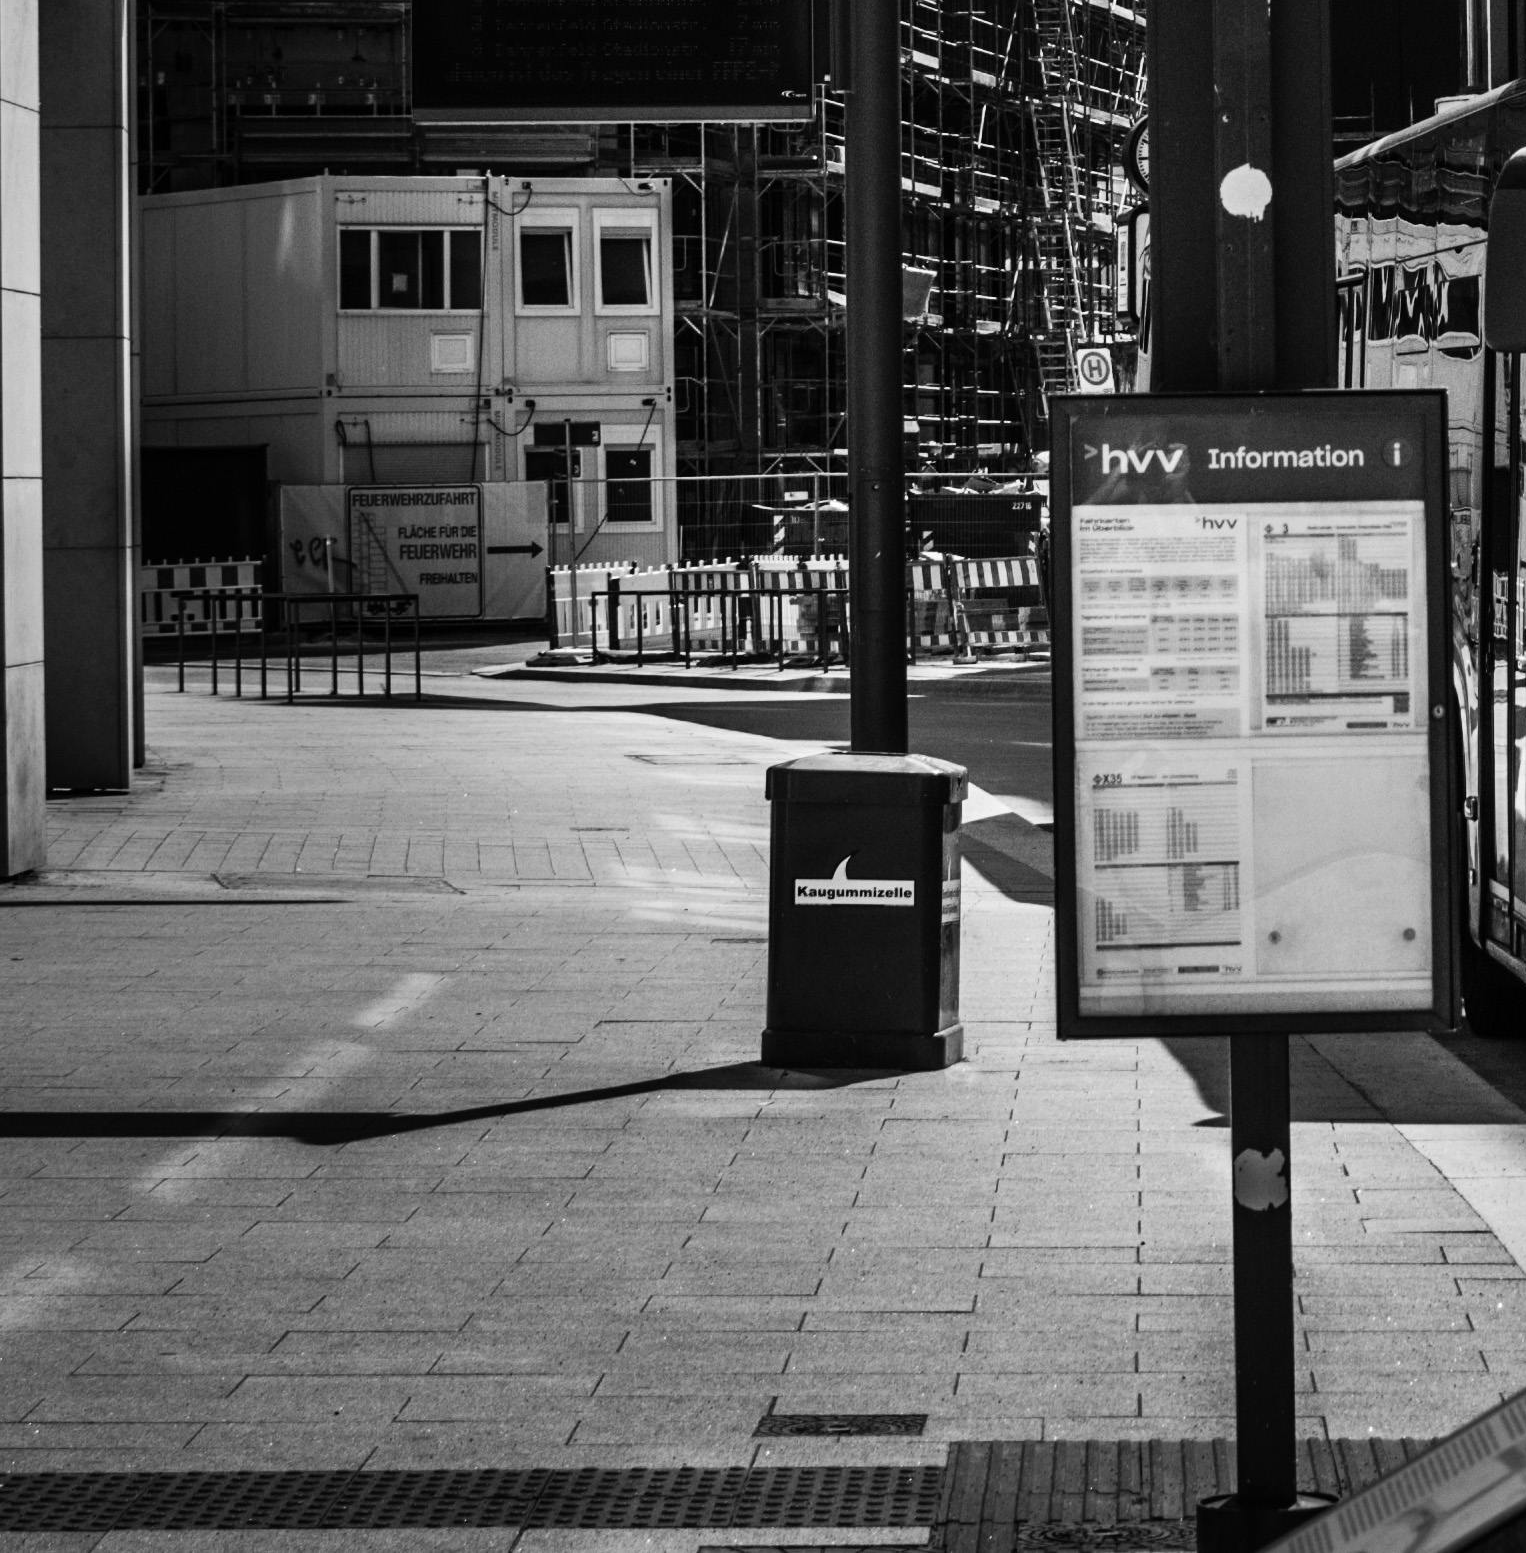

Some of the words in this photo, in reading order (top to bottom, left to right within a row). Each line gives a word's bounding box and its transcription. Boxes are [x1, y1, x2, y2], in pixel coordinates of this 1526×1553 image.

[1208, 444, 1364, 469] Information
[352, 492, 477, 507] FEUERWEHRZUFAHRT
[398, 525, 437, 539] FLÄCHE
[400, 543, 477, 560] FEUERWEHR
[419, 572, 478, 585] FREIHALTEN
[798, 886, 913, 900] Kaugummizelle
